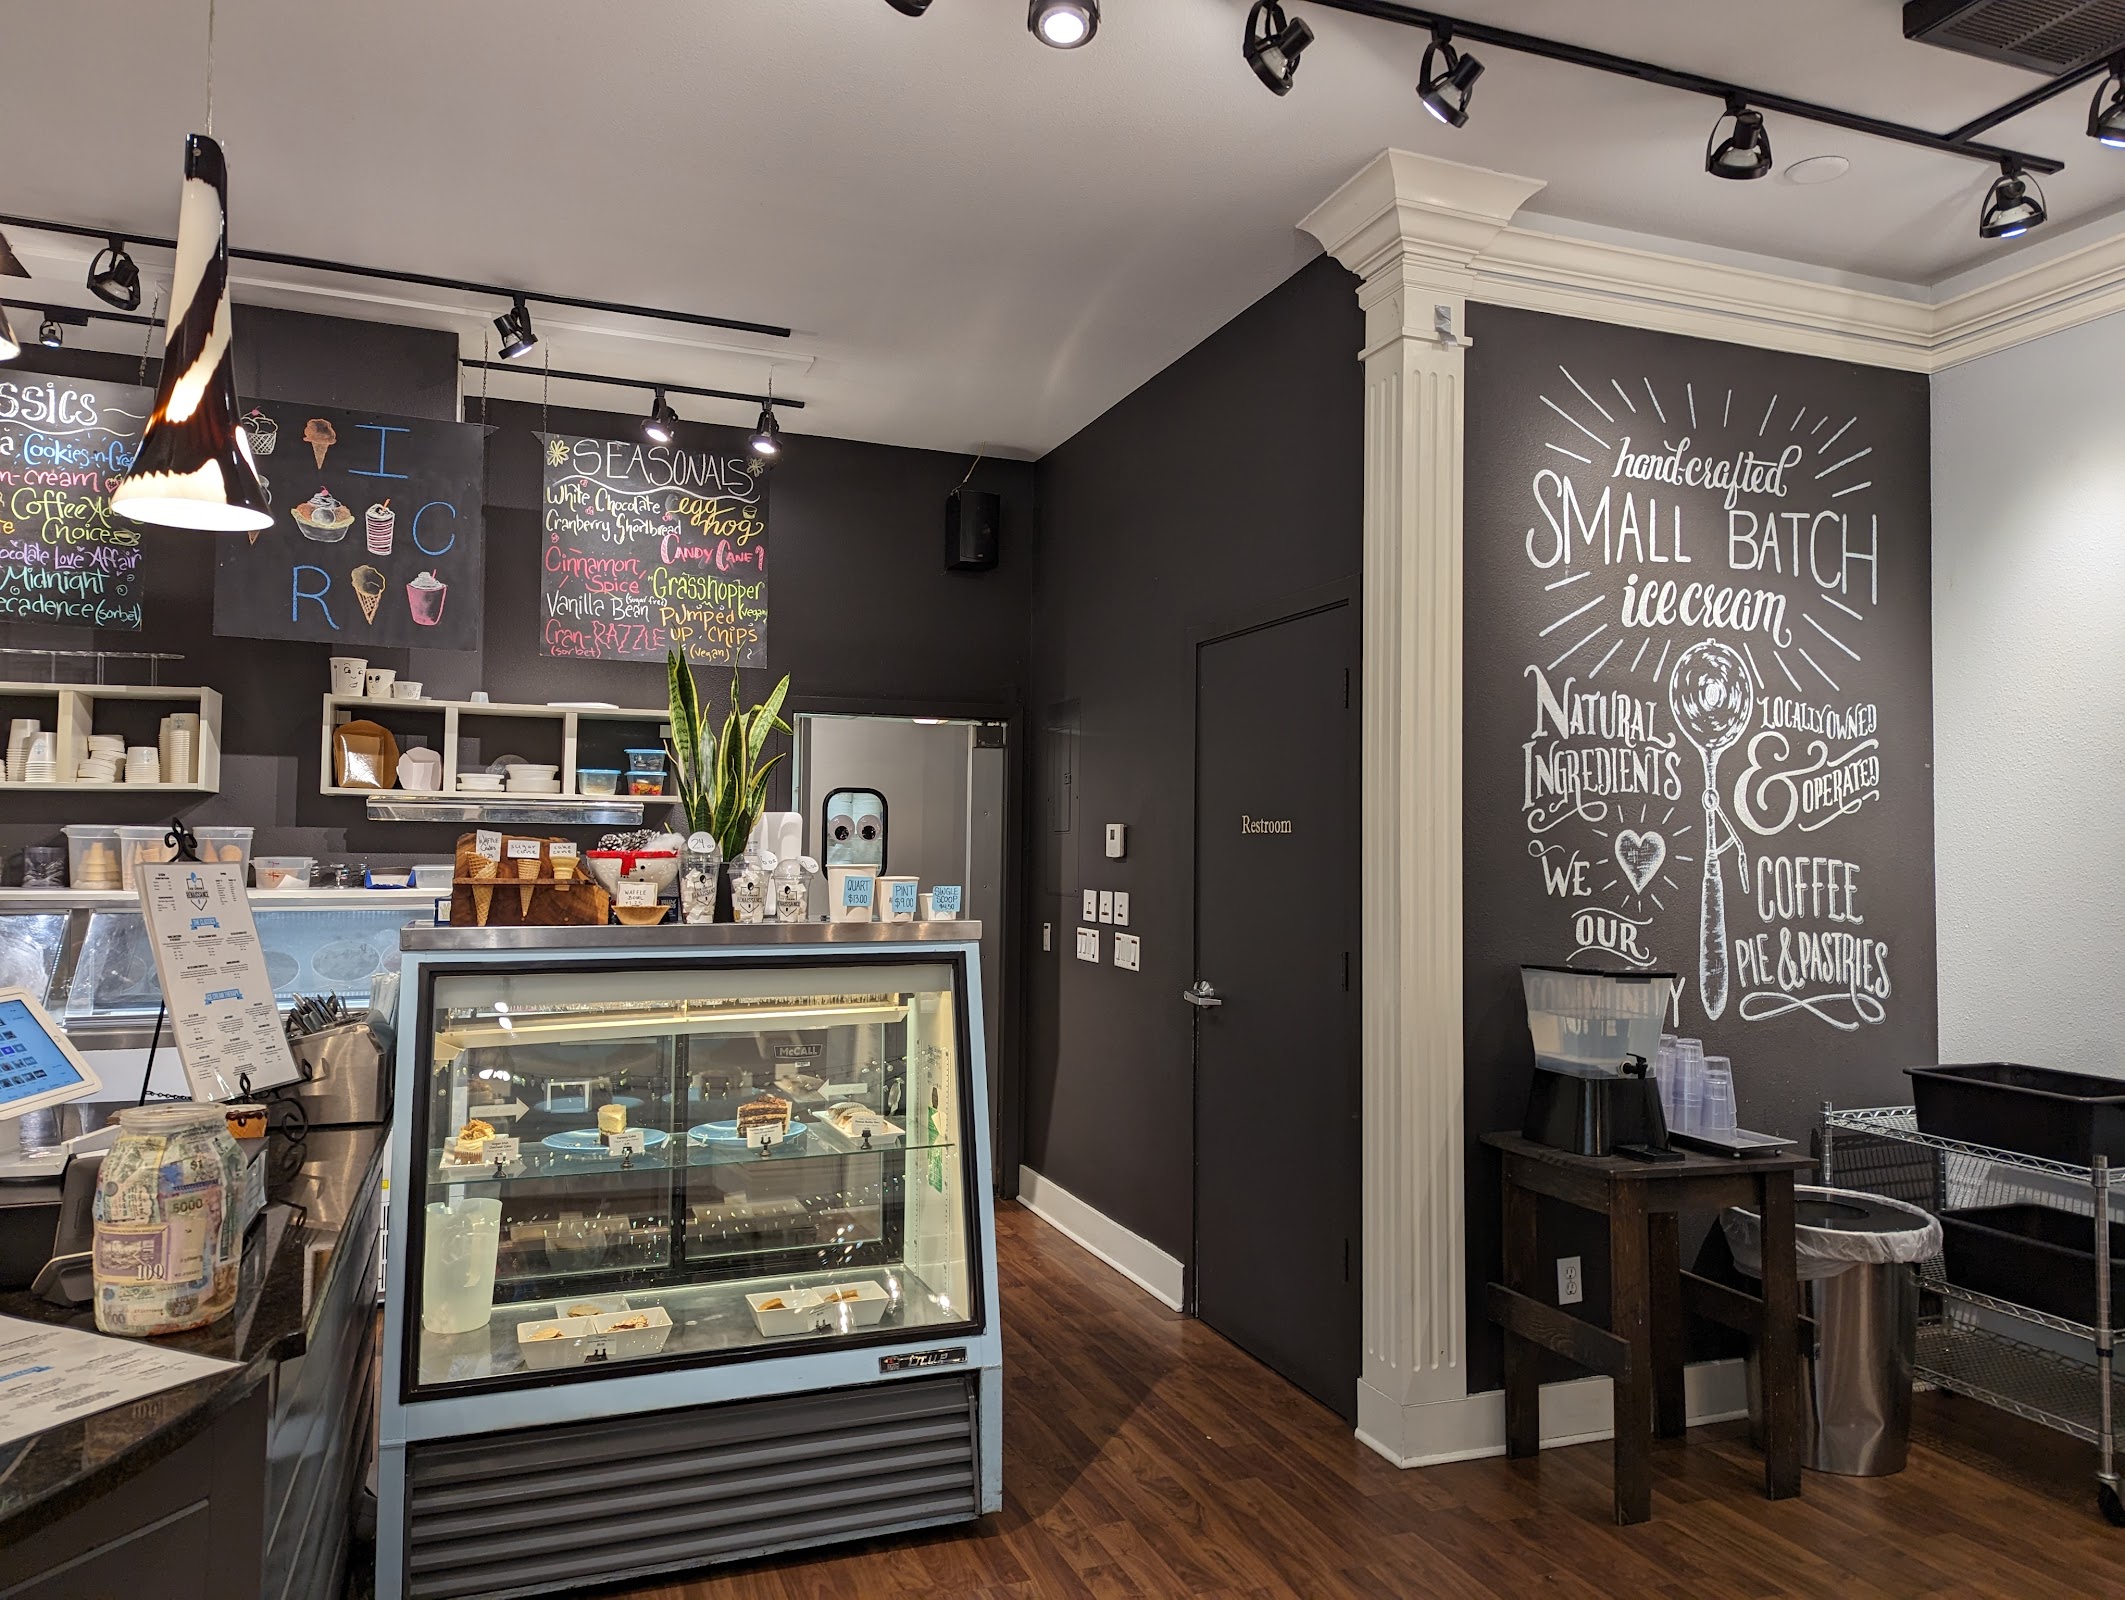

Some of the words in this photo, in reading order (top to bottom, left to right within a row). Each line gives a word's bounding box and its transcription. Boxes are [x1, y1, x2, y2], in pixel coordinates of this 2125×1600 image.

[573, 440, 754, 497] SEASONALS
[1611, 437, 1802, 510] hand-crafted
[11, 487, 87, 520] Coffee
[546, 484, 590, 512] White
[595, 488, 661, 517] Chocolate
[672, 497, 736, 527] egg
[42, 517, 110, 544] Choice
[413, 501, 456, 556] C
[546, 509, 611, 542] Cranberry
[614, 512, 682, 544] Shortbread
[698, 518, 764, 546] nog
[1525, 469, 1691, 568] SMALL
[1728, 510, 1878, 605] BATCH
[55, 547, 84, 569] Love
[85, 548, 142, 572] Affair
[545, 546, 640, 578] Cinnamon
[0, 567, 109, 598] Midnight
[292, 565, 340, 630] R
[585, 574, 640, 594] Spice
[653, 566, 765, 609] Grasshopper
[95, 603, 141, 628] (sorbet)
[546, 590, 605, 618] Vanilla
[611, 597, 650, 622] Bean
[1621, 574, 1678, 628] ice
[1679, 580, 1792, 648] cream
[550, 646, 602, 658] (sorbet)
[690, 643, 730, 662] (vegan)
[1523, 664, 1676, 749] NATURAL
[1757, 696, 1827, 731] LOCALLY
[1825, 704, 1878, 741] OWNED
[1521, 741, 1681, 815] INGREDIENTS
[1734, 731, 1828, 836] &
[1802, 756, 1880, 815] OPERATED
[1241, 814, 1292, 834] Restroom
[511, 844, 536, 852] sugar
[691, 838, 705, 849] 24
[1528, 840, 1592, 898] WE
[847, 880, 869, 891] QUART
[848, 894, 867, 904] $13.00
[895, 885, 915, 897] PINT
[934, 887, 958, 896] SINGLE
[937, 895, 958, 903] SCOOP
[1757, 856, 1864, 924] COFFEE
[895, 898, 914, 908] $9.00
[1575, 915, 1650, 960] OUR
[1735, 933, 1774, 988] PIE
[1777, 927, 1804, 991] &
[1799, 932, 1891, 999] PASTRIES
[780, 1046, 817, 1056] McCALL
[172, 1198, 203, 1214] 5000
[136, 1264, 164, 1281] 100
